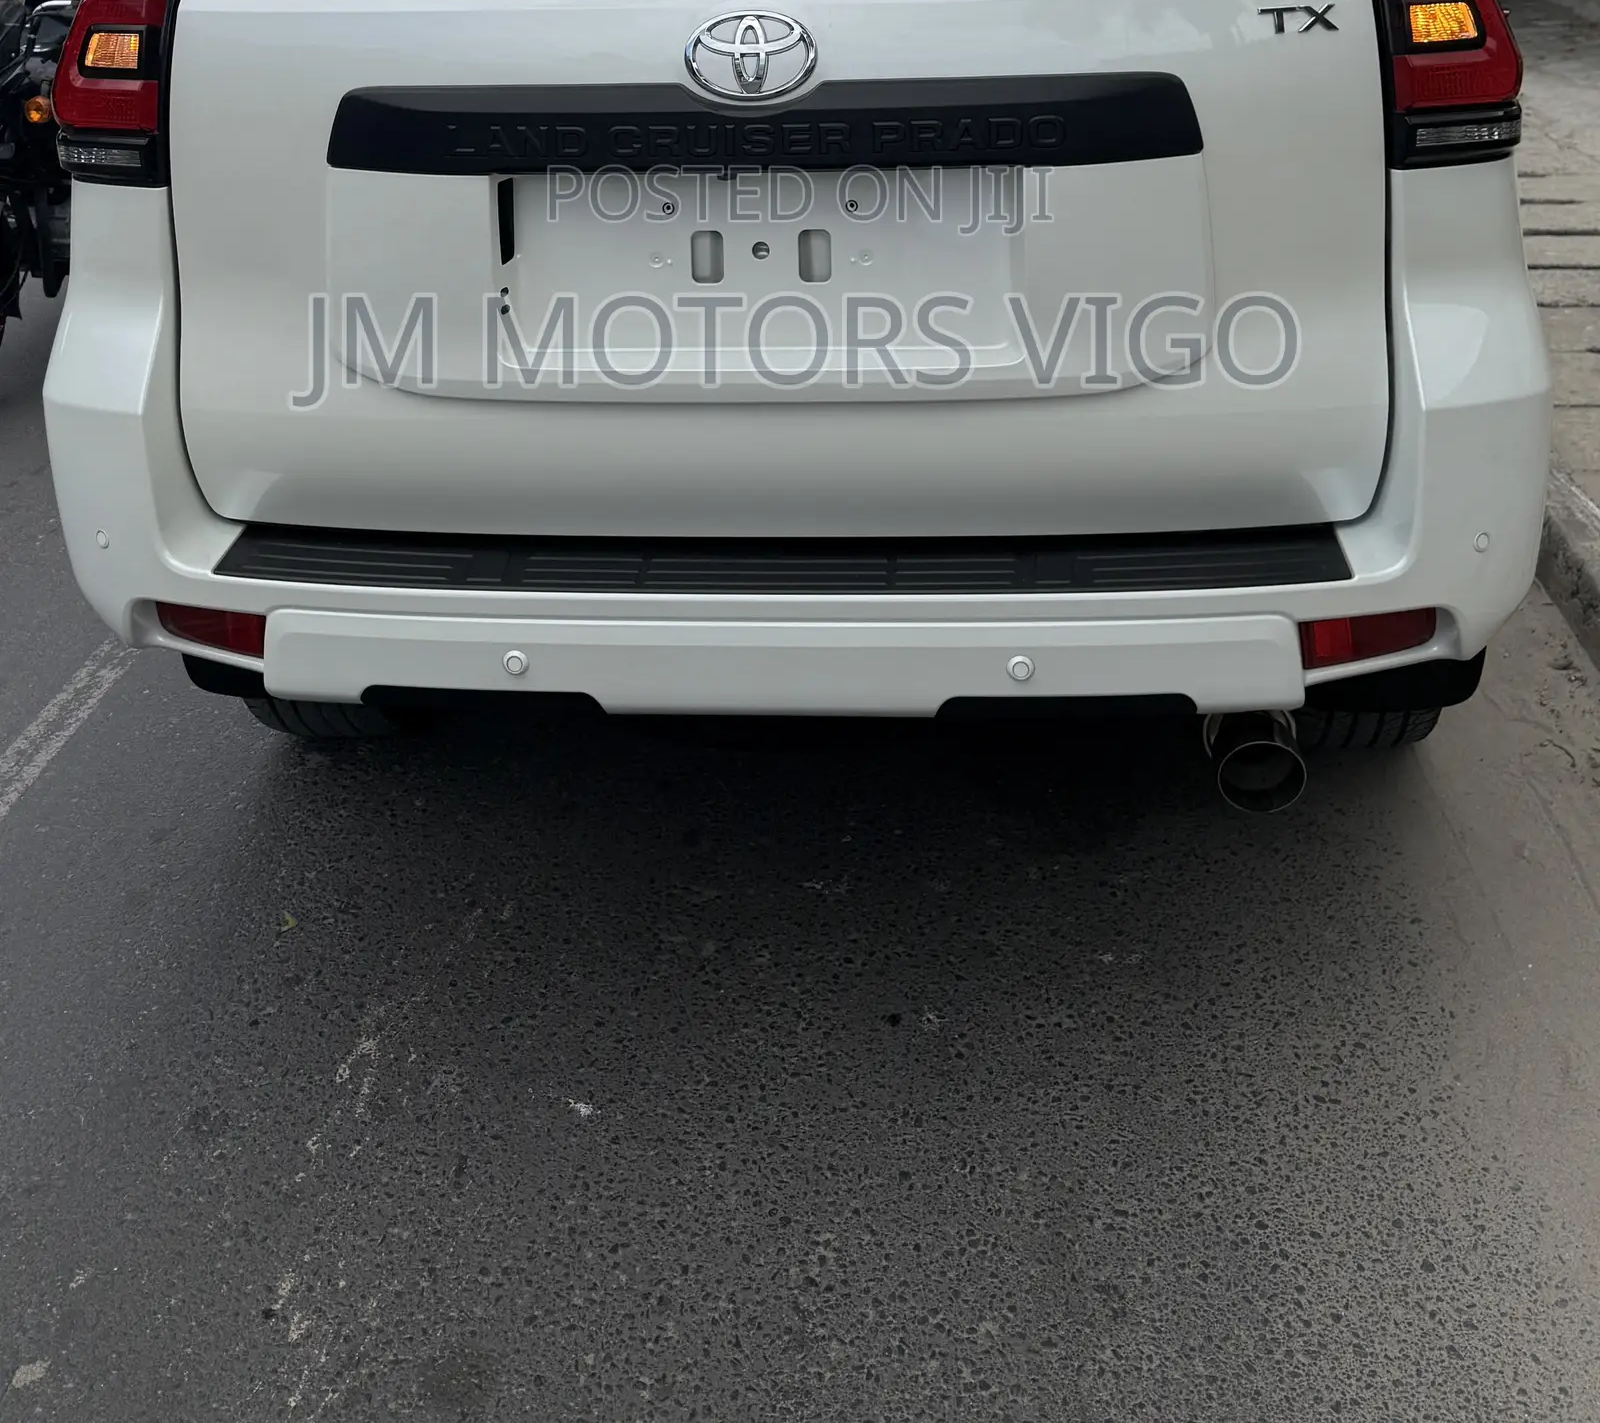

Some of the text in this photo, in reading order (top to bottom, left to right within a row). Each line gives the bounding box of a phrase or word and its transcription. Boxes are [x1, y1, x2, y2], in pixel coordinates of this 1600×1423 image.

[1257, 2, 1340, 34] TX
[446, 114, 1068, 158] LAND CRUISER PRADO
